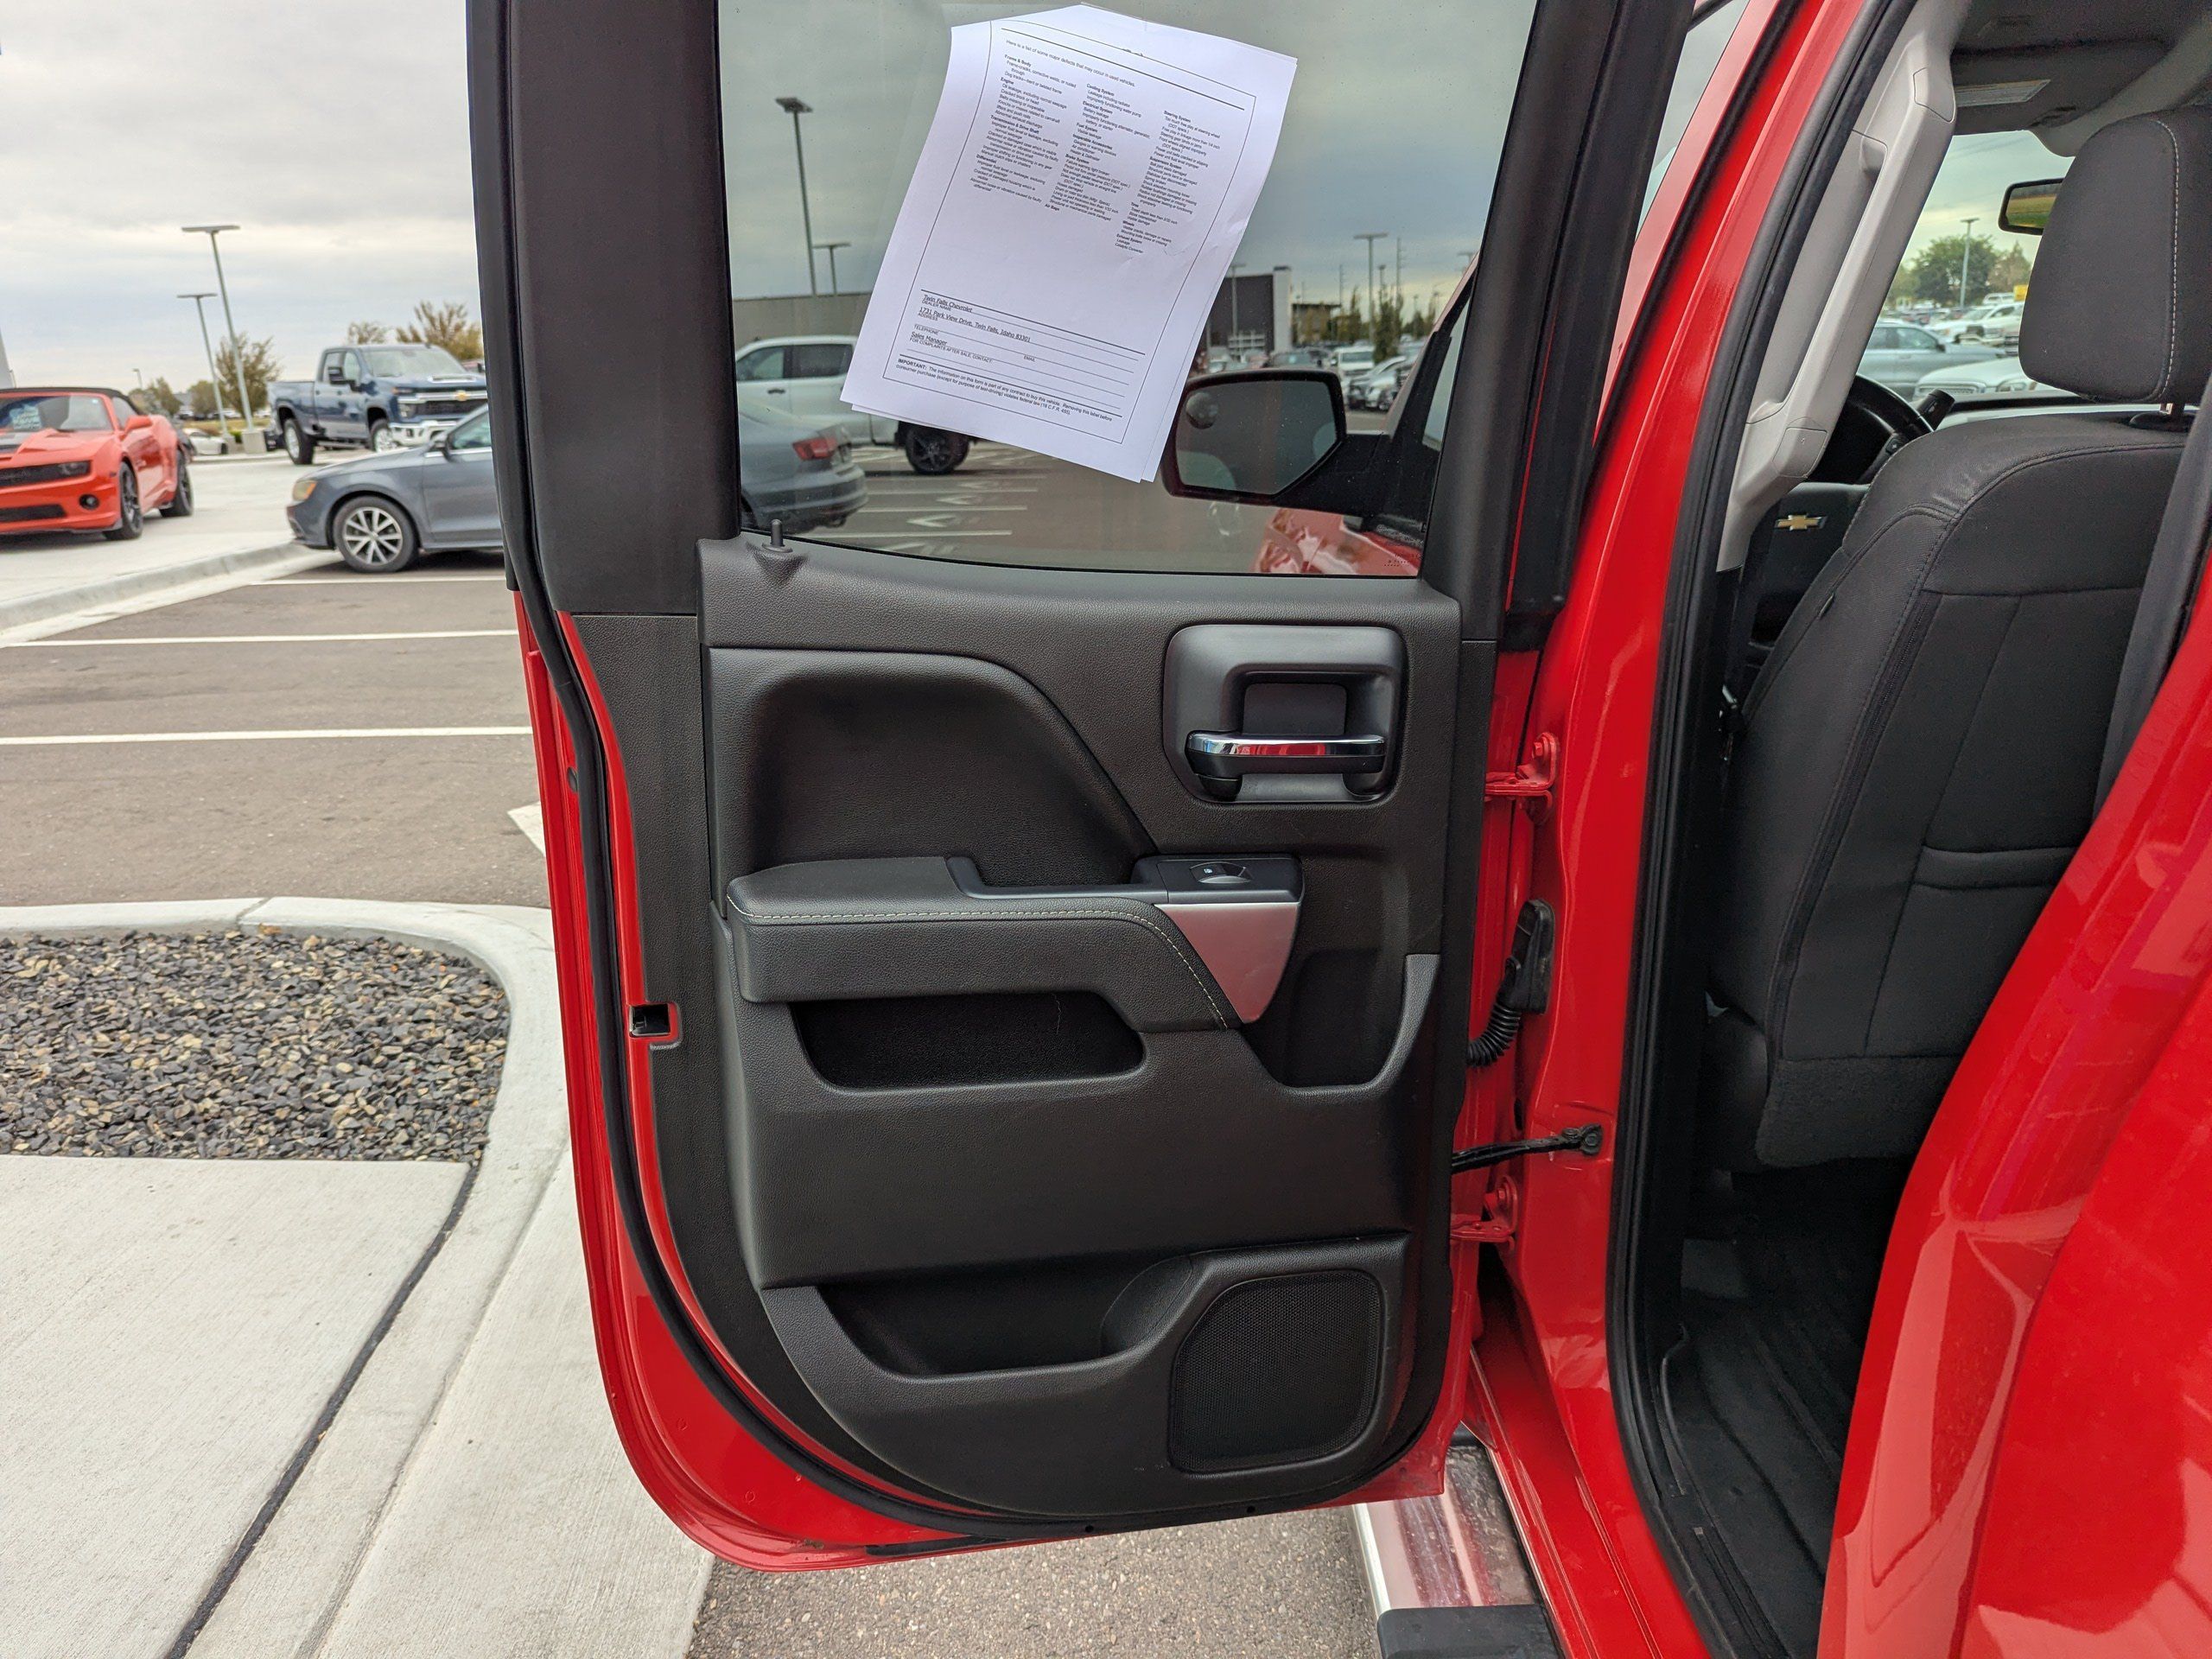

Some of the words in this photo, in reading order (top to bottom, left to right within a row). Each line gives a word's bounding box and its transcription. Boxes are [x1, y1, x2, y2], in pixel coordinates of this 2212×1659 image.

[948, 302, 973, 312] Chevrolet
[925, 335, 947, 346] Manager
[986, 326, 1000, 334] Falls,
[1000, 329, 1014, 338] Idaho
[1014, 334, 1032, 342] 83301
[919, 340, 946, 350] COMPLAINTS
[896, 365, 917, 373] consumer
[917, 370, 937, 379] purchase
[937, 375, 953, 384] (except
[981, 386, 1004, 397] test-driving)
[898, 358, 928, 370] IMPORTANT:
[938, 368, 960, 378] information
[1062, 403, 1083, 413] Removing
